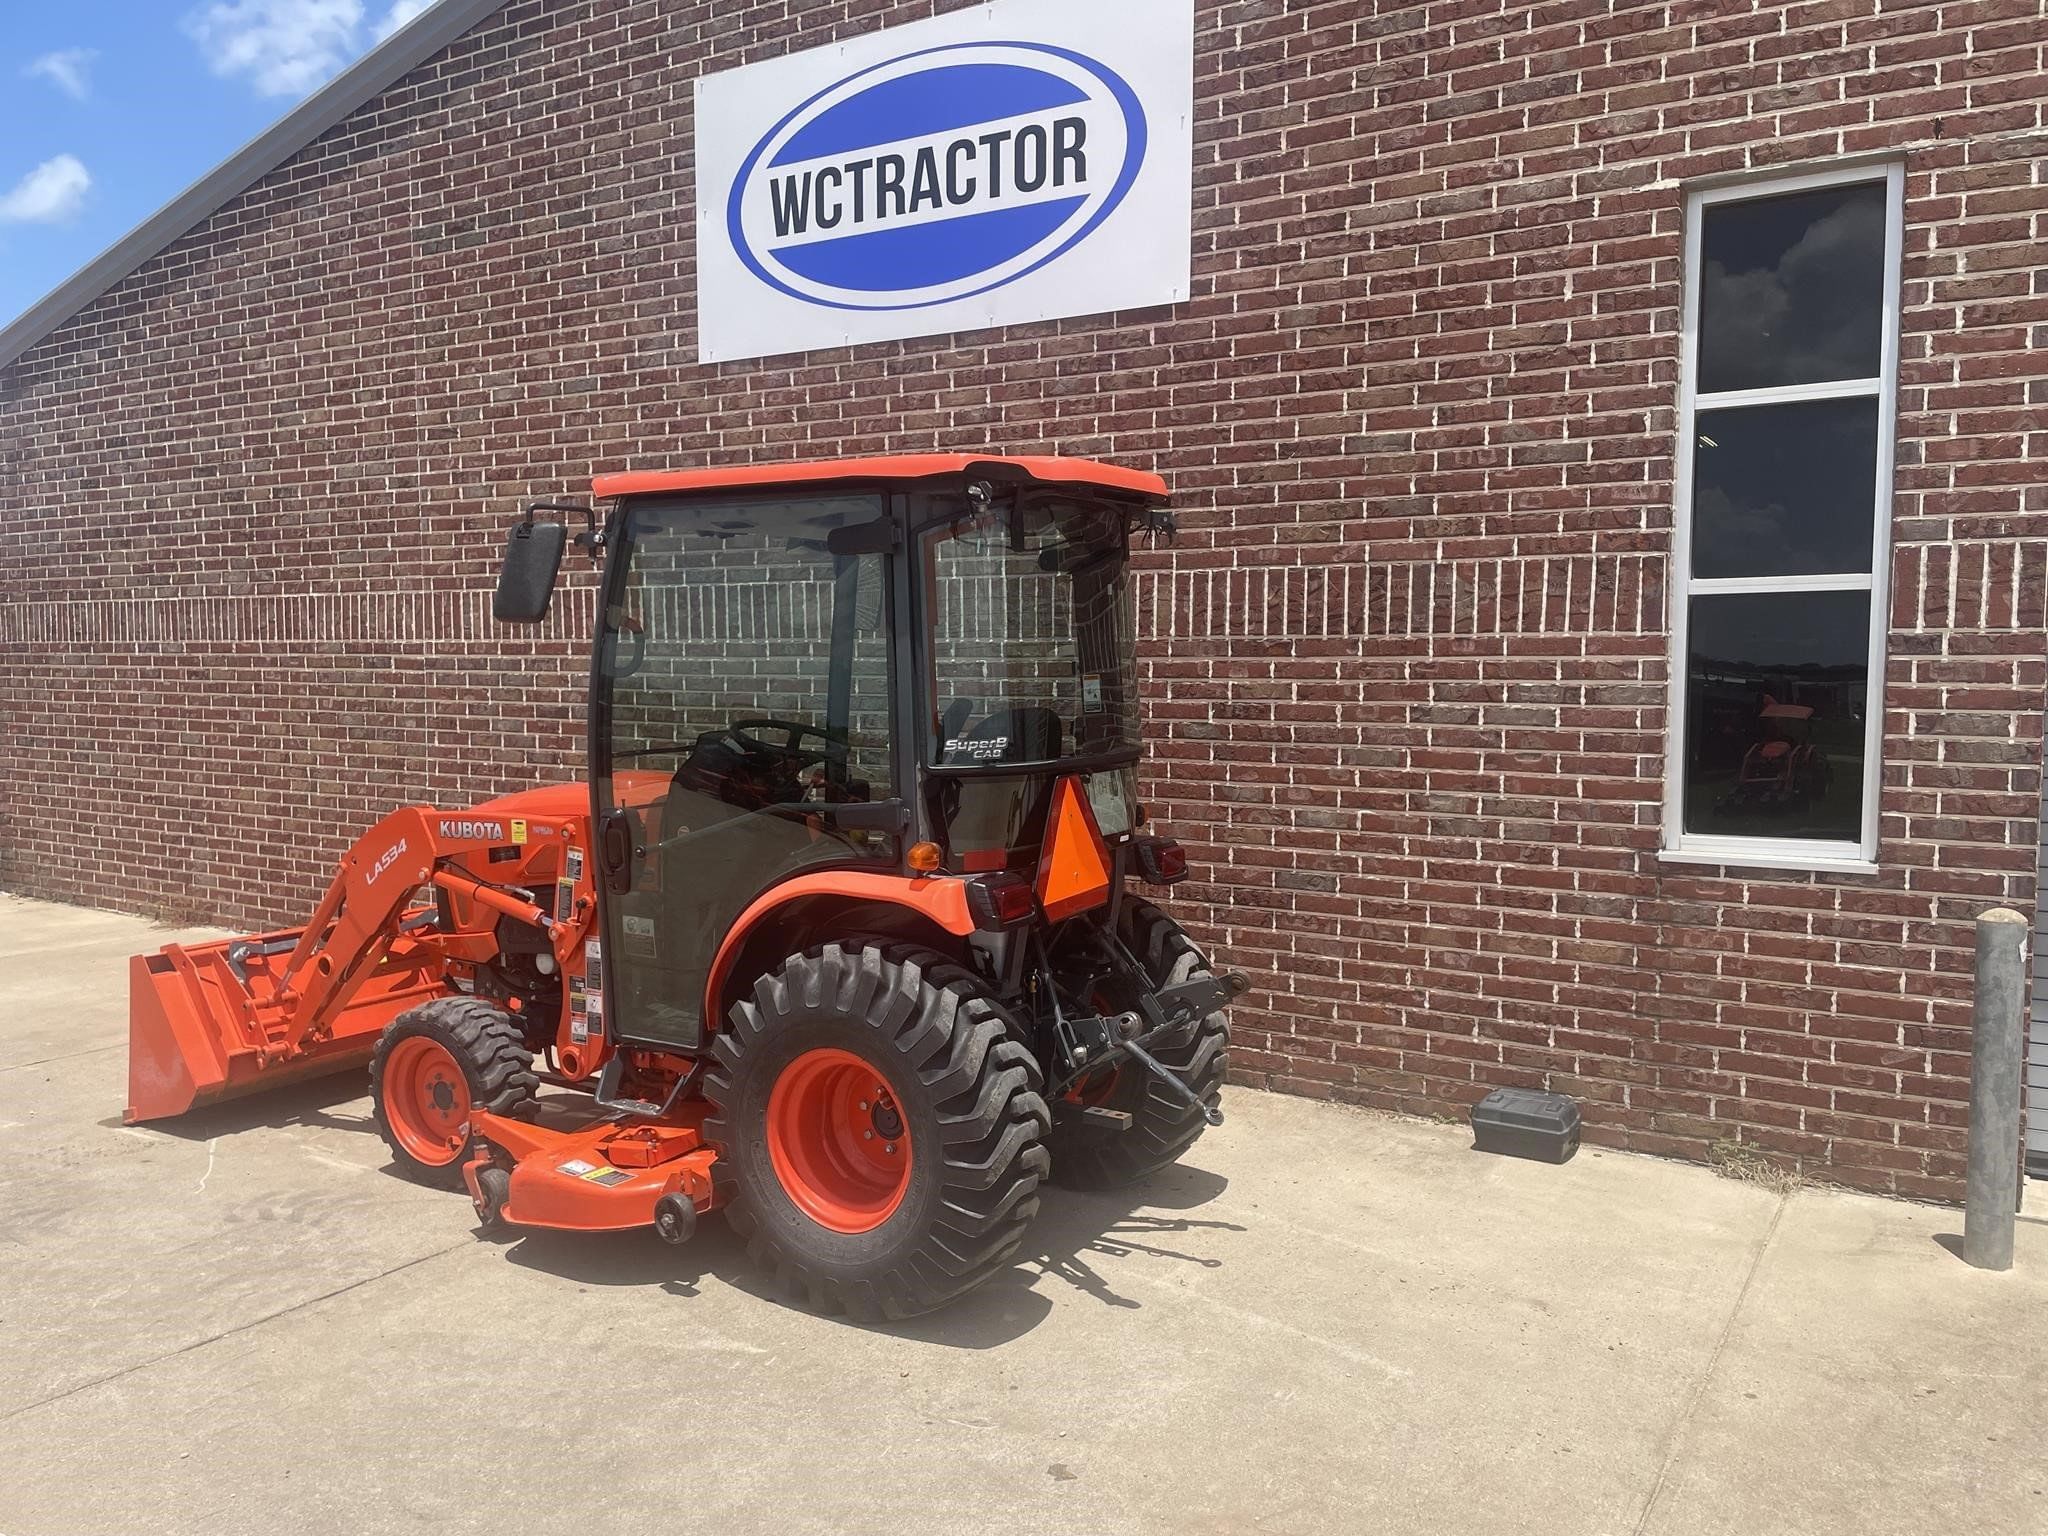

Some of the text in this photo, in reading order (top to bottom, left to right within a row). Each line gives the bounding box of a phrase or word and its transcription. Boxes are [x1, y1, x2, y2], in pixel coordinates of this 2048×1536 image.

[770, 116, 1087, 238] WCTRACTOR
[943, 737, 1008, 751] SuperB
[439, 820, 504, 840] KUBOTA
[366, 837, 408, 885] LA534
